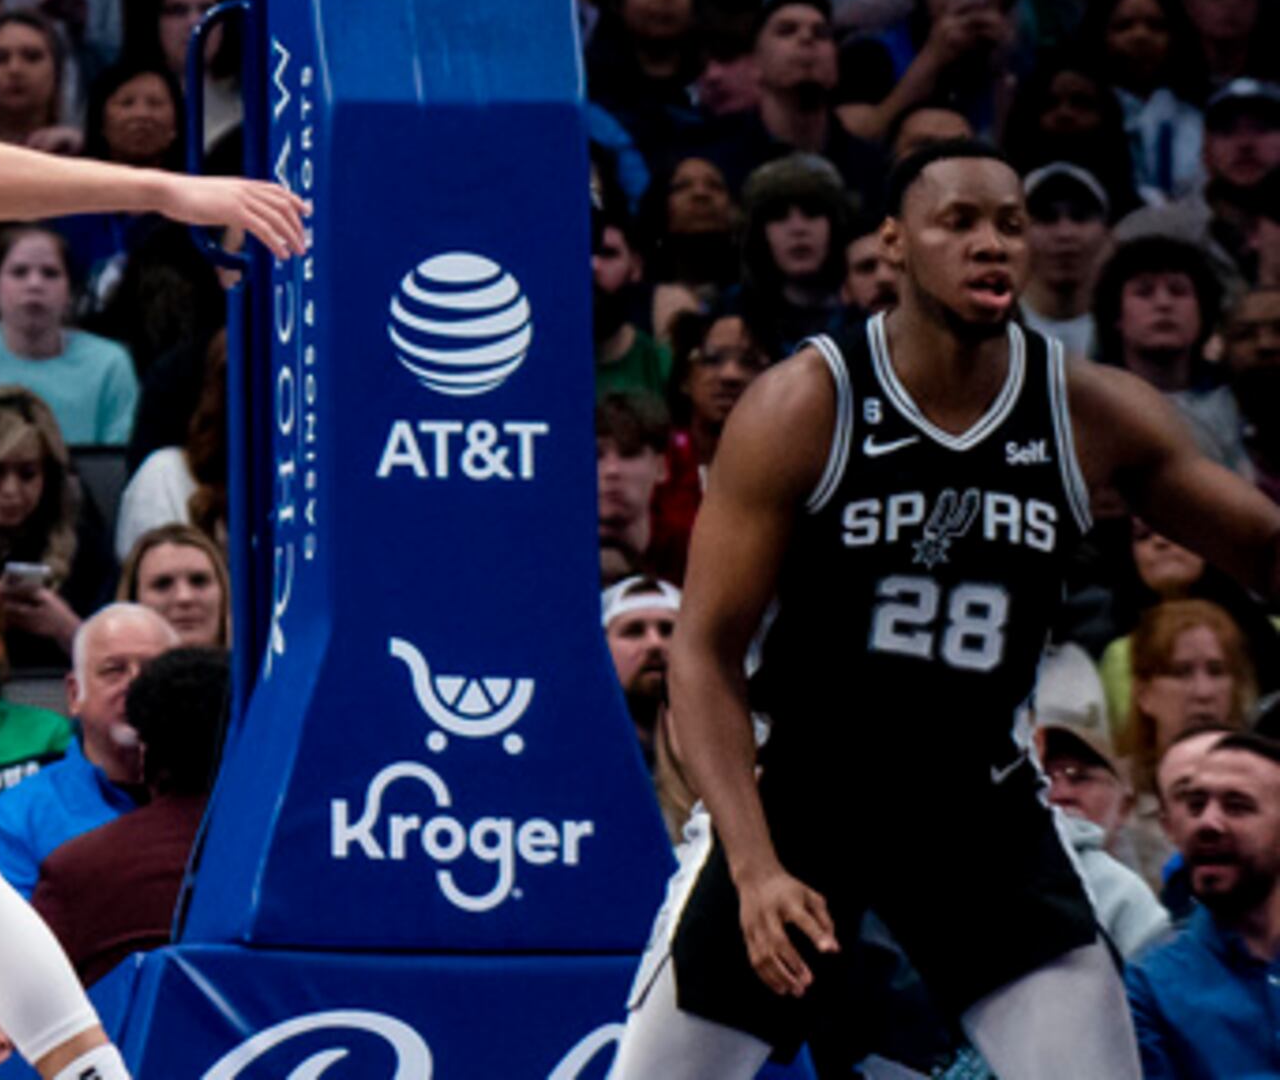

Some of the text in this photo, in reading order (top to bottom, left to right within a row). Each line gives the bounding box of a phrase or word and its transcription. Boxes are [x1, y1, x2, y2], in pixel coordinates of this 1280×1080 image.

[272, 35, 295, 655] CHOCAW
[376, 420, 550, 480] AT&T
[842, 487, 1059, 570] SPURS
[868, 574, 1009, 672] 28
[330, 761, 595, 912] Kroger
